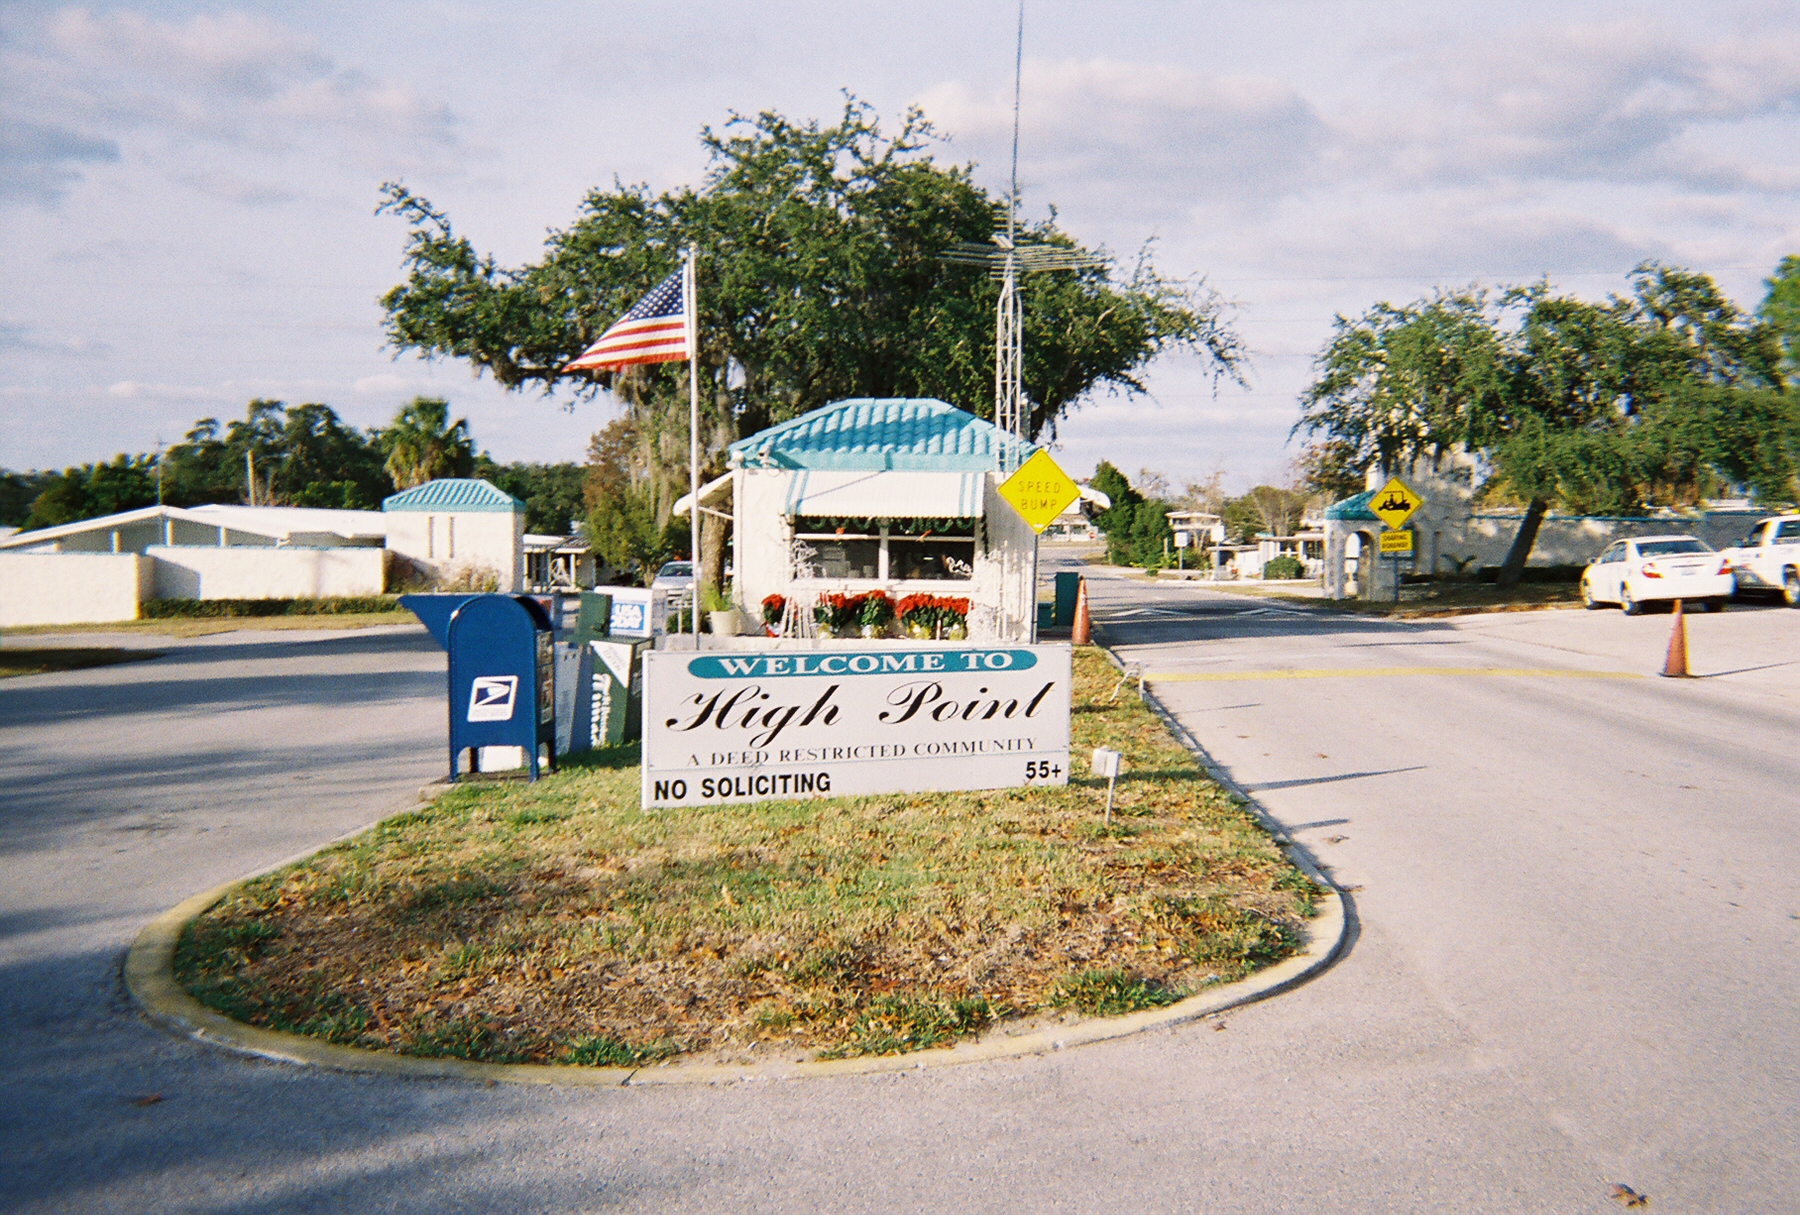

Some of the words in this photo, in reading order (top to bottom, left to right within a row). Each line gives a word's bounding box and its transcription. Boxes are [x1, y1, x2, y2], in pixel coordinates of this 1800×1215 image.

[1018, 480, 1061, 494] SPEED
[1021, 498, 1057, 511] BUMP
[717, 653, 946, 676] WELCOME
[959, 652, 1014, 670] TO
[665, 684, 842, 749] High
[878, 680, 1056, 725] Point
[687, 753, 700, 767] A
[711, 750, 769, 766] DEED
[779, 743, 906, 762] RESTRICTED
[913, 737, 1037, 756] COMMUNITY
[1025, 760, 1062, 780] 55+
[654, 779, 687, 801] NO
[701, 772, 831, 799] SOLICITING
